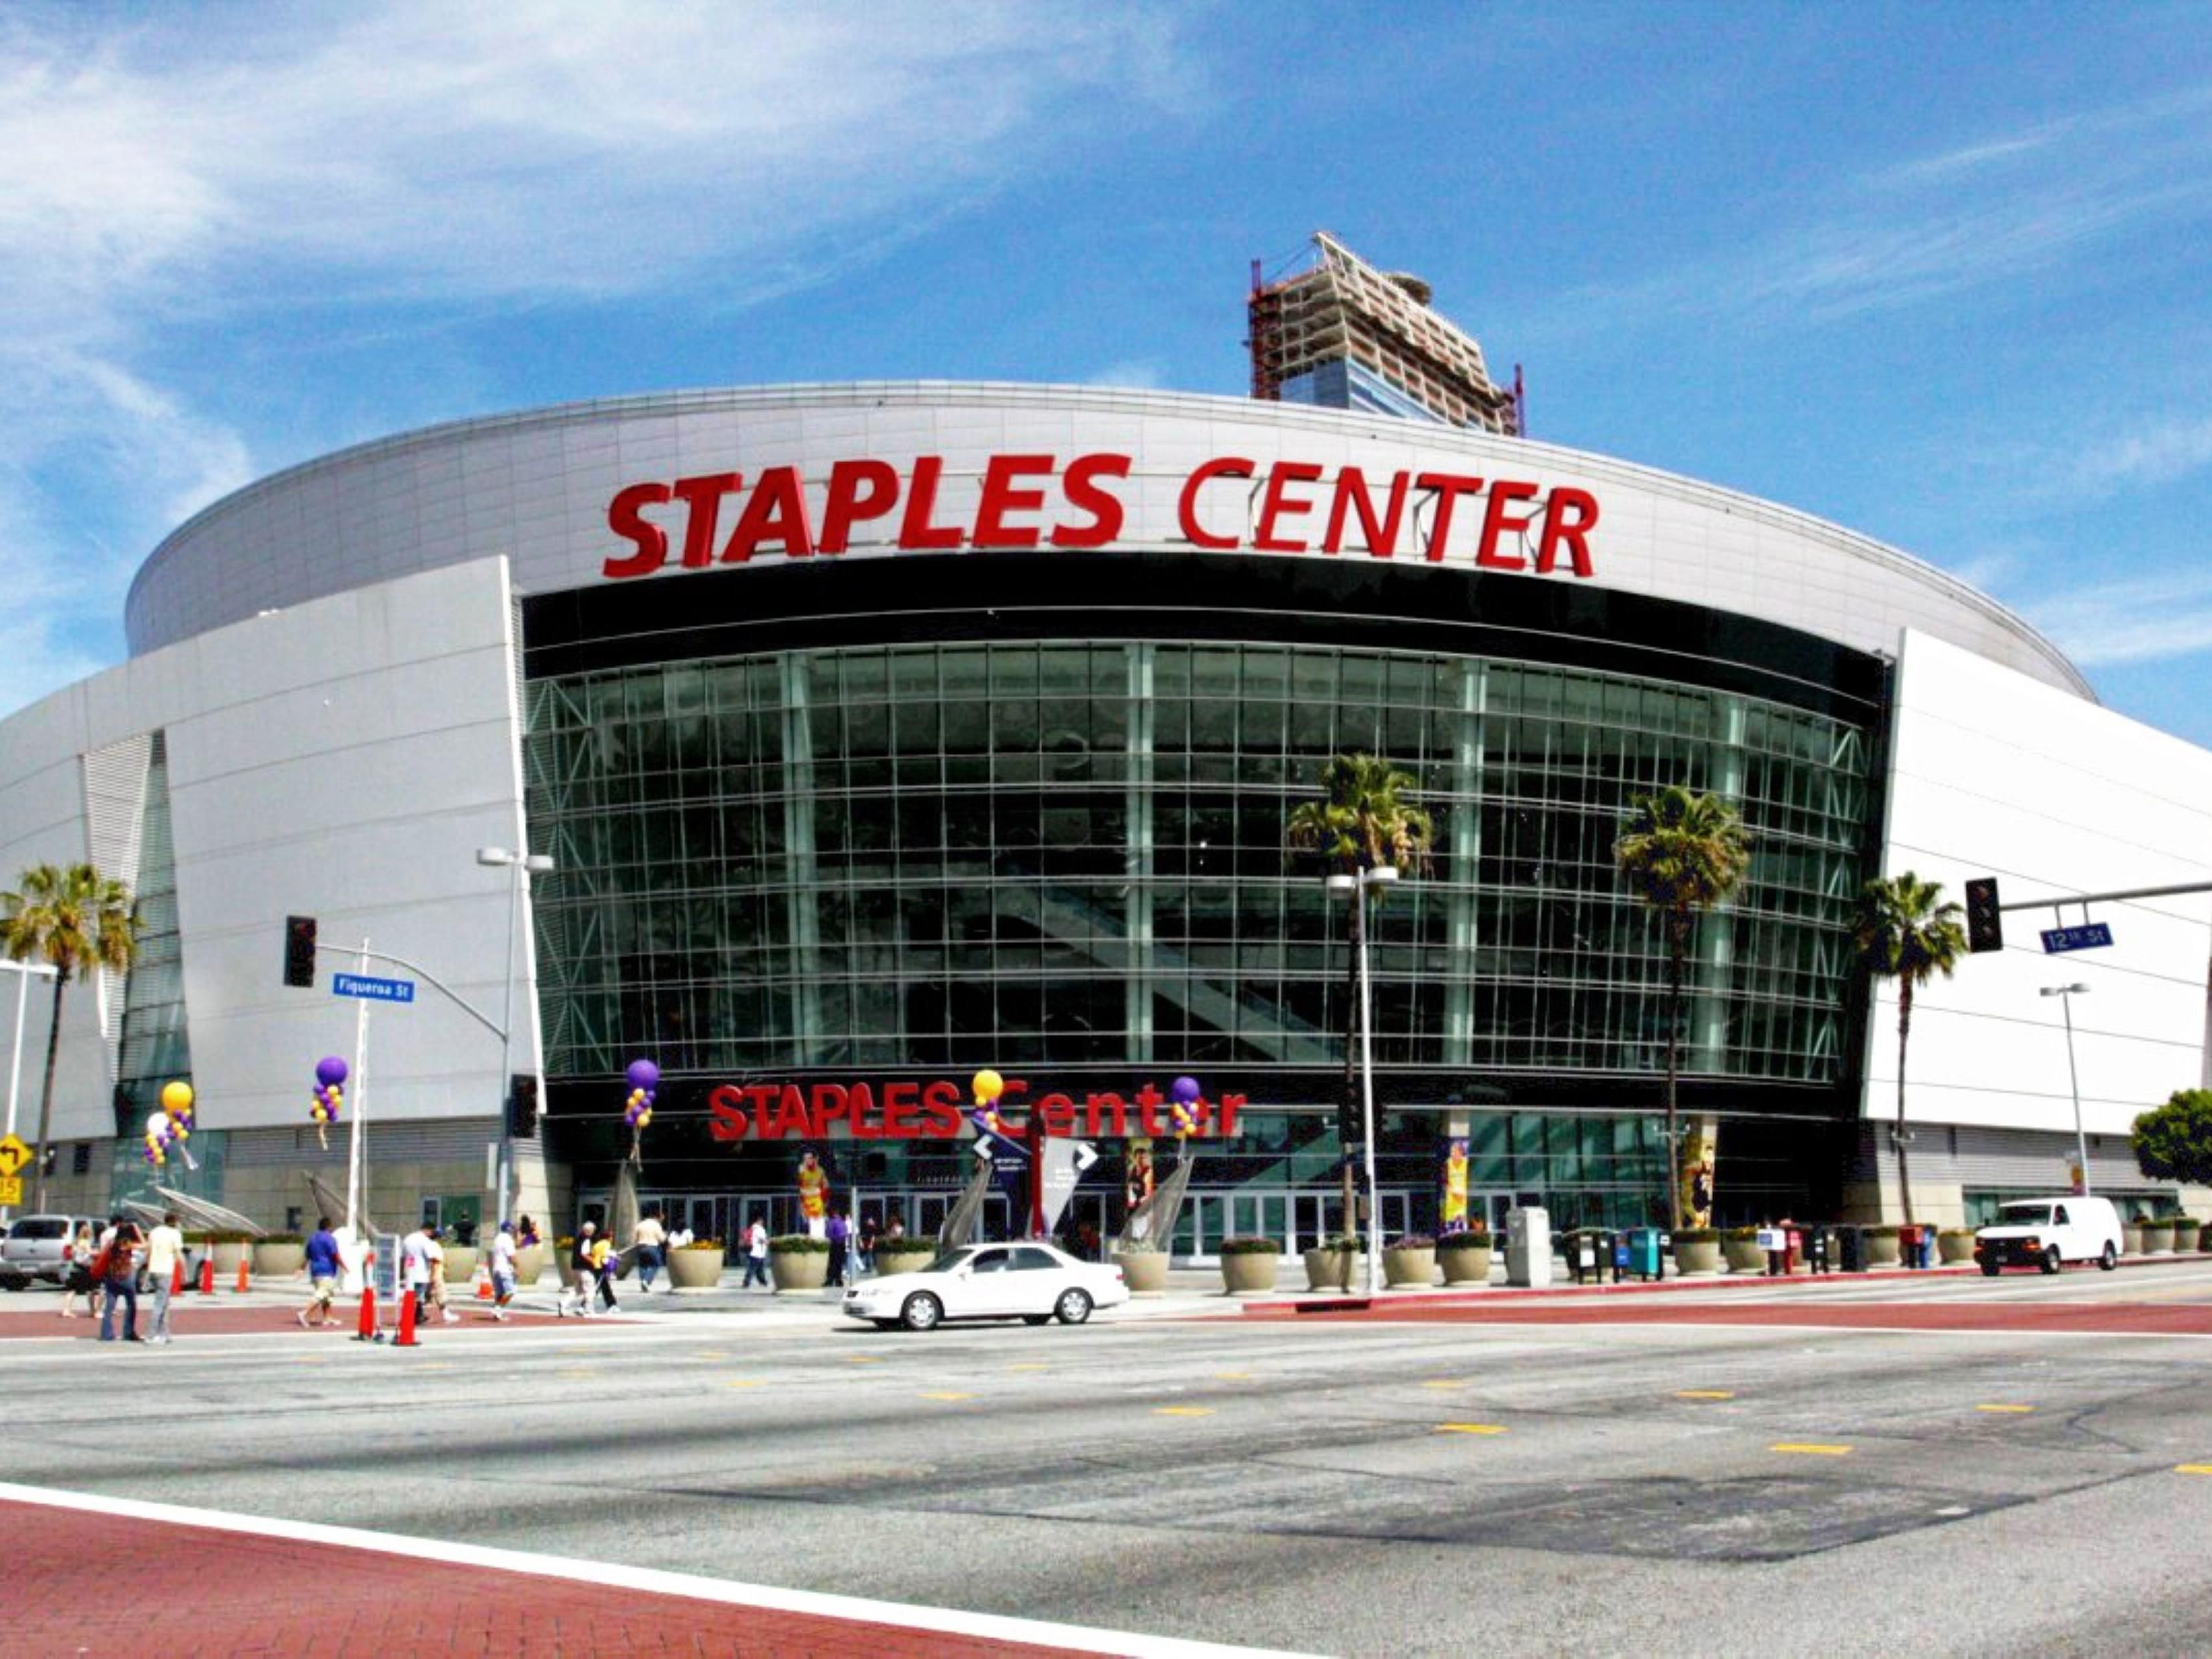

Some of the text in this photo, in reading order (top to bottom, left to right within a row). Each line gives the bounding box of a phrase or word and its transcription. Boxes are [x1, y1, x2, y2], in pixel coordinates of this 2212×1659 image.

[604, 454, 1600, 577] STAPLES CENTER
[2087, 929, 2106, 944] St
[340, 977, 410, 999] Figueroa St
[709, 1081, 962, 1139] STAPLES
